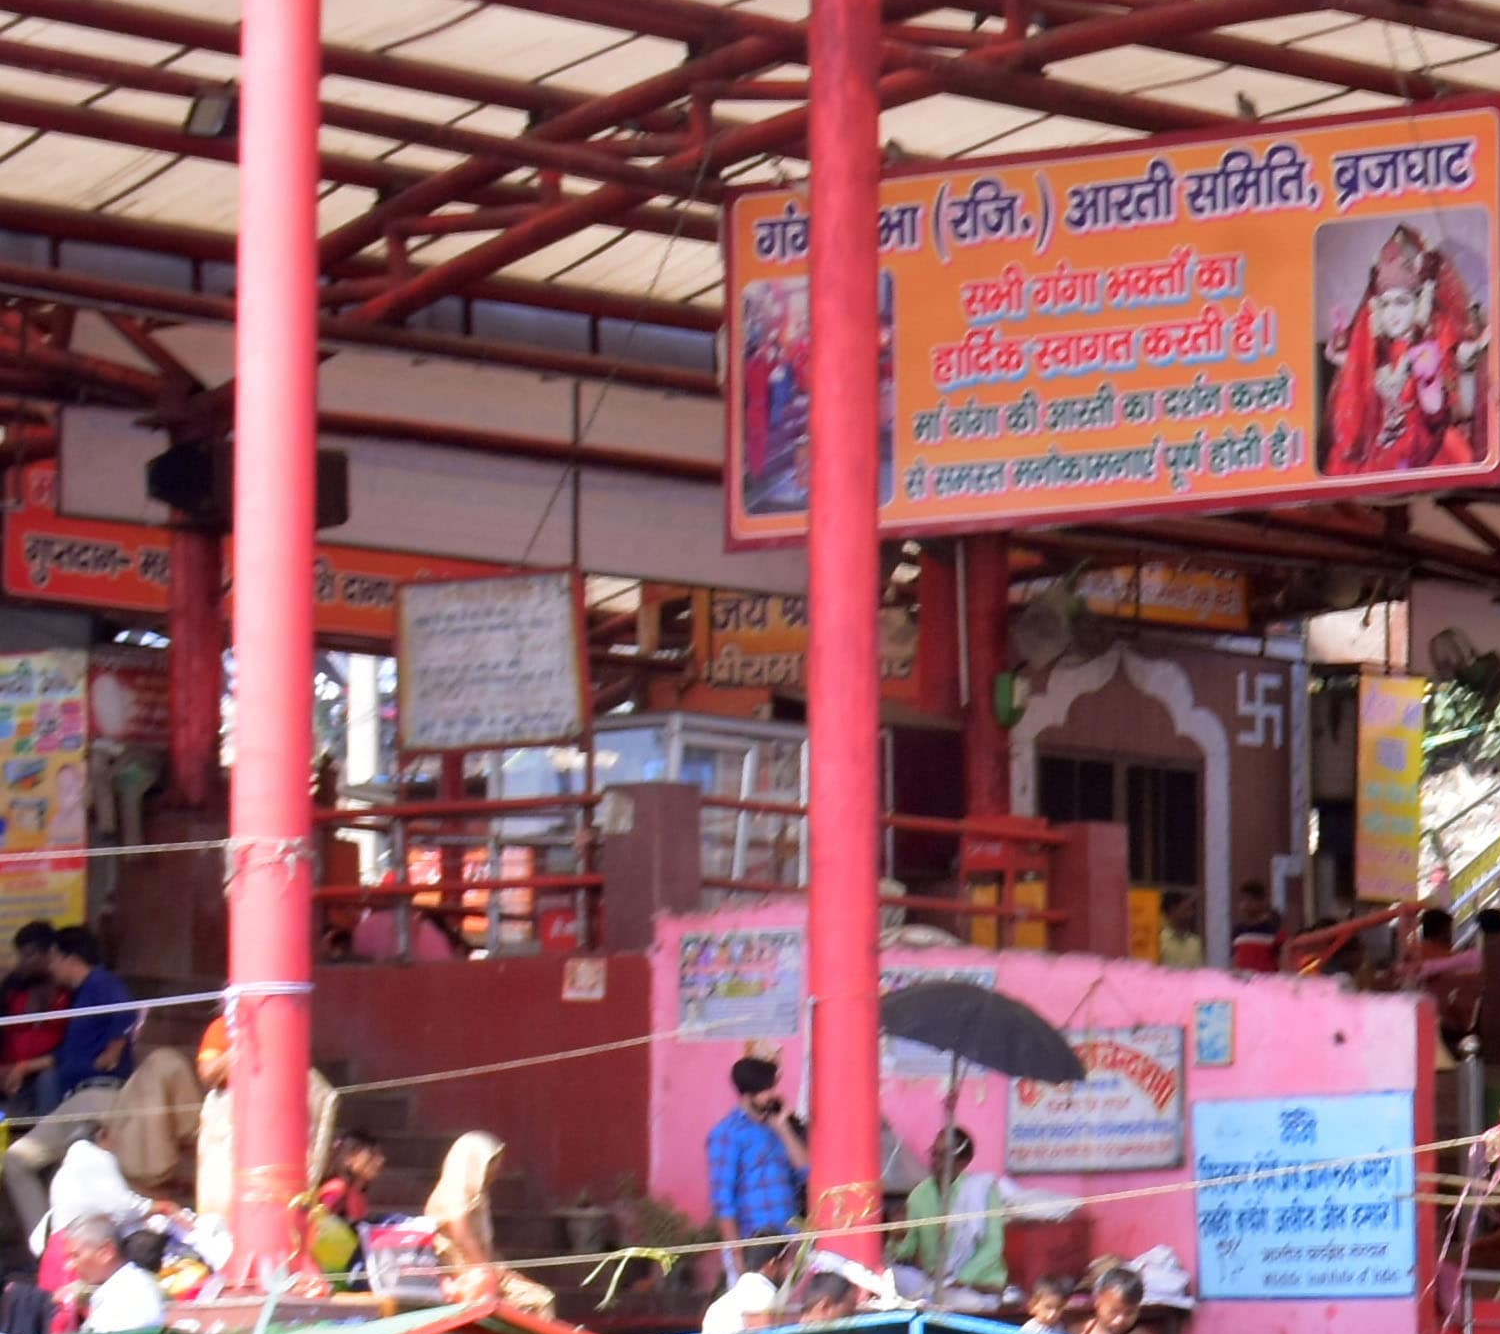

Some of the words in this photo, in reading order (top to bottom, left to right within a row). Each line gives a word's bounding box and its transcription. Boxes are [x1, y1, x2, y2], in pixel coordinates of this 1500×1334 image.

[931, 172, 1052, 261] (रजि.)
[1066, 160, 1173, 229] आरती
[1186, 145, 1318, 215] समिति,
[1333, 140, 1471, 208] ब्रजघाट
[963, 265, 1024, 319] सभी
[1031, 259, 1098, 312] गंगा
[1108, 247, 1188, 307] भक्तों
[1195, 255, 1245, 299] का
[932, 327, 1024, 389] हार्दिक
[1032, 330, 1136, 377] स्वागत
[1143, 302, 1225, 367] करती
[949, 396, 1000, 438] गंगा
[1006, 386, 1040, 436] की
[1046, 382, 1117, 433] आरती
[1122, 390, 1156, 422] का
[1229, 365, 1295, 411] करने
[905, 456, 929, 501] से
